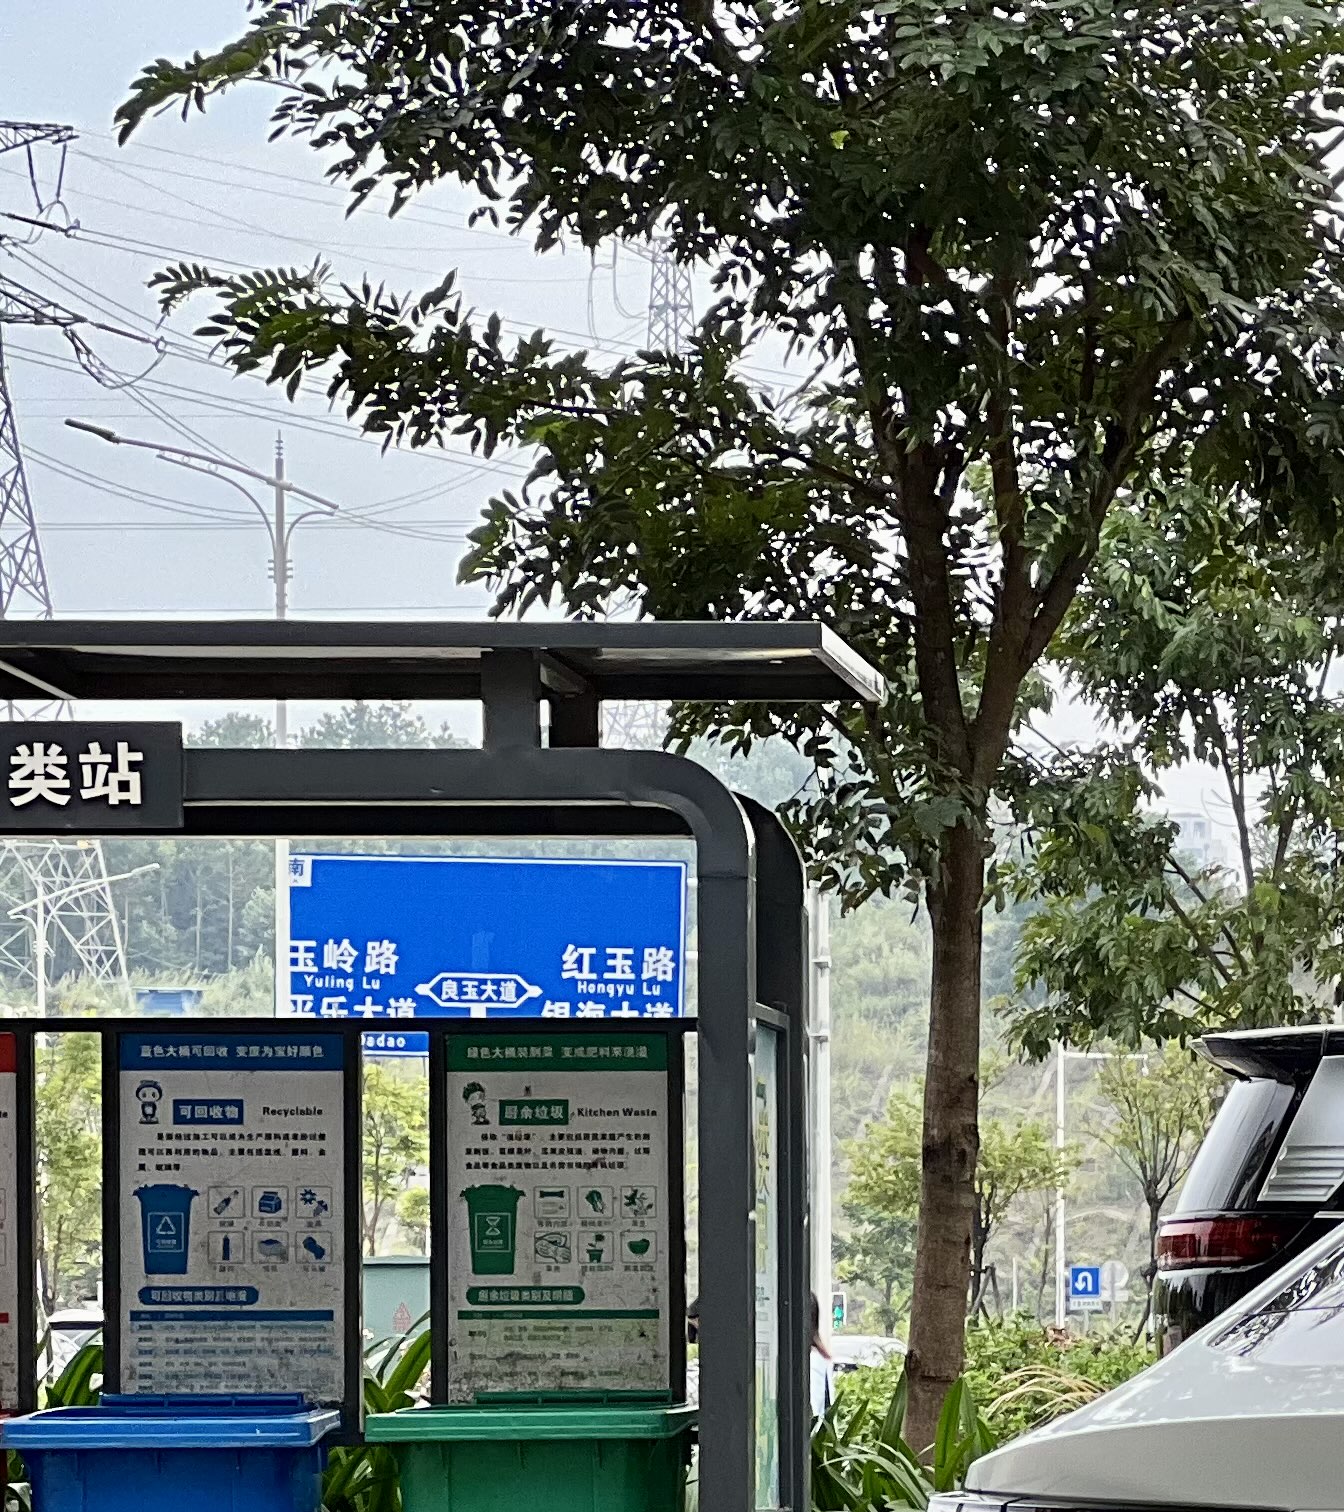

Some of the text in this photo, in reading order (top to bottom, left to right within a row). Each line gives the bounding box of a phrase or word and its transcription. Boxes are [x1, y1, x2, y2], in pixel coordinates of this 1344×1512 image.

[8, 741, 144, 807] 类站
[290, 938, 400, 975] 玉岭路
[561, 944, 676, 982] 红玉路
[304, 973, 381, 992] Yuling Lu
[441, 979, 519, 1003] 良玉大道
[577, 980, 661, 998] Hongyu Lu
[178, 1104, 240, 1120] 可回收物
[262, 1106, 324, 1118] Recyclable
[576, 1107, 658, 1118] Kitchen Waste
